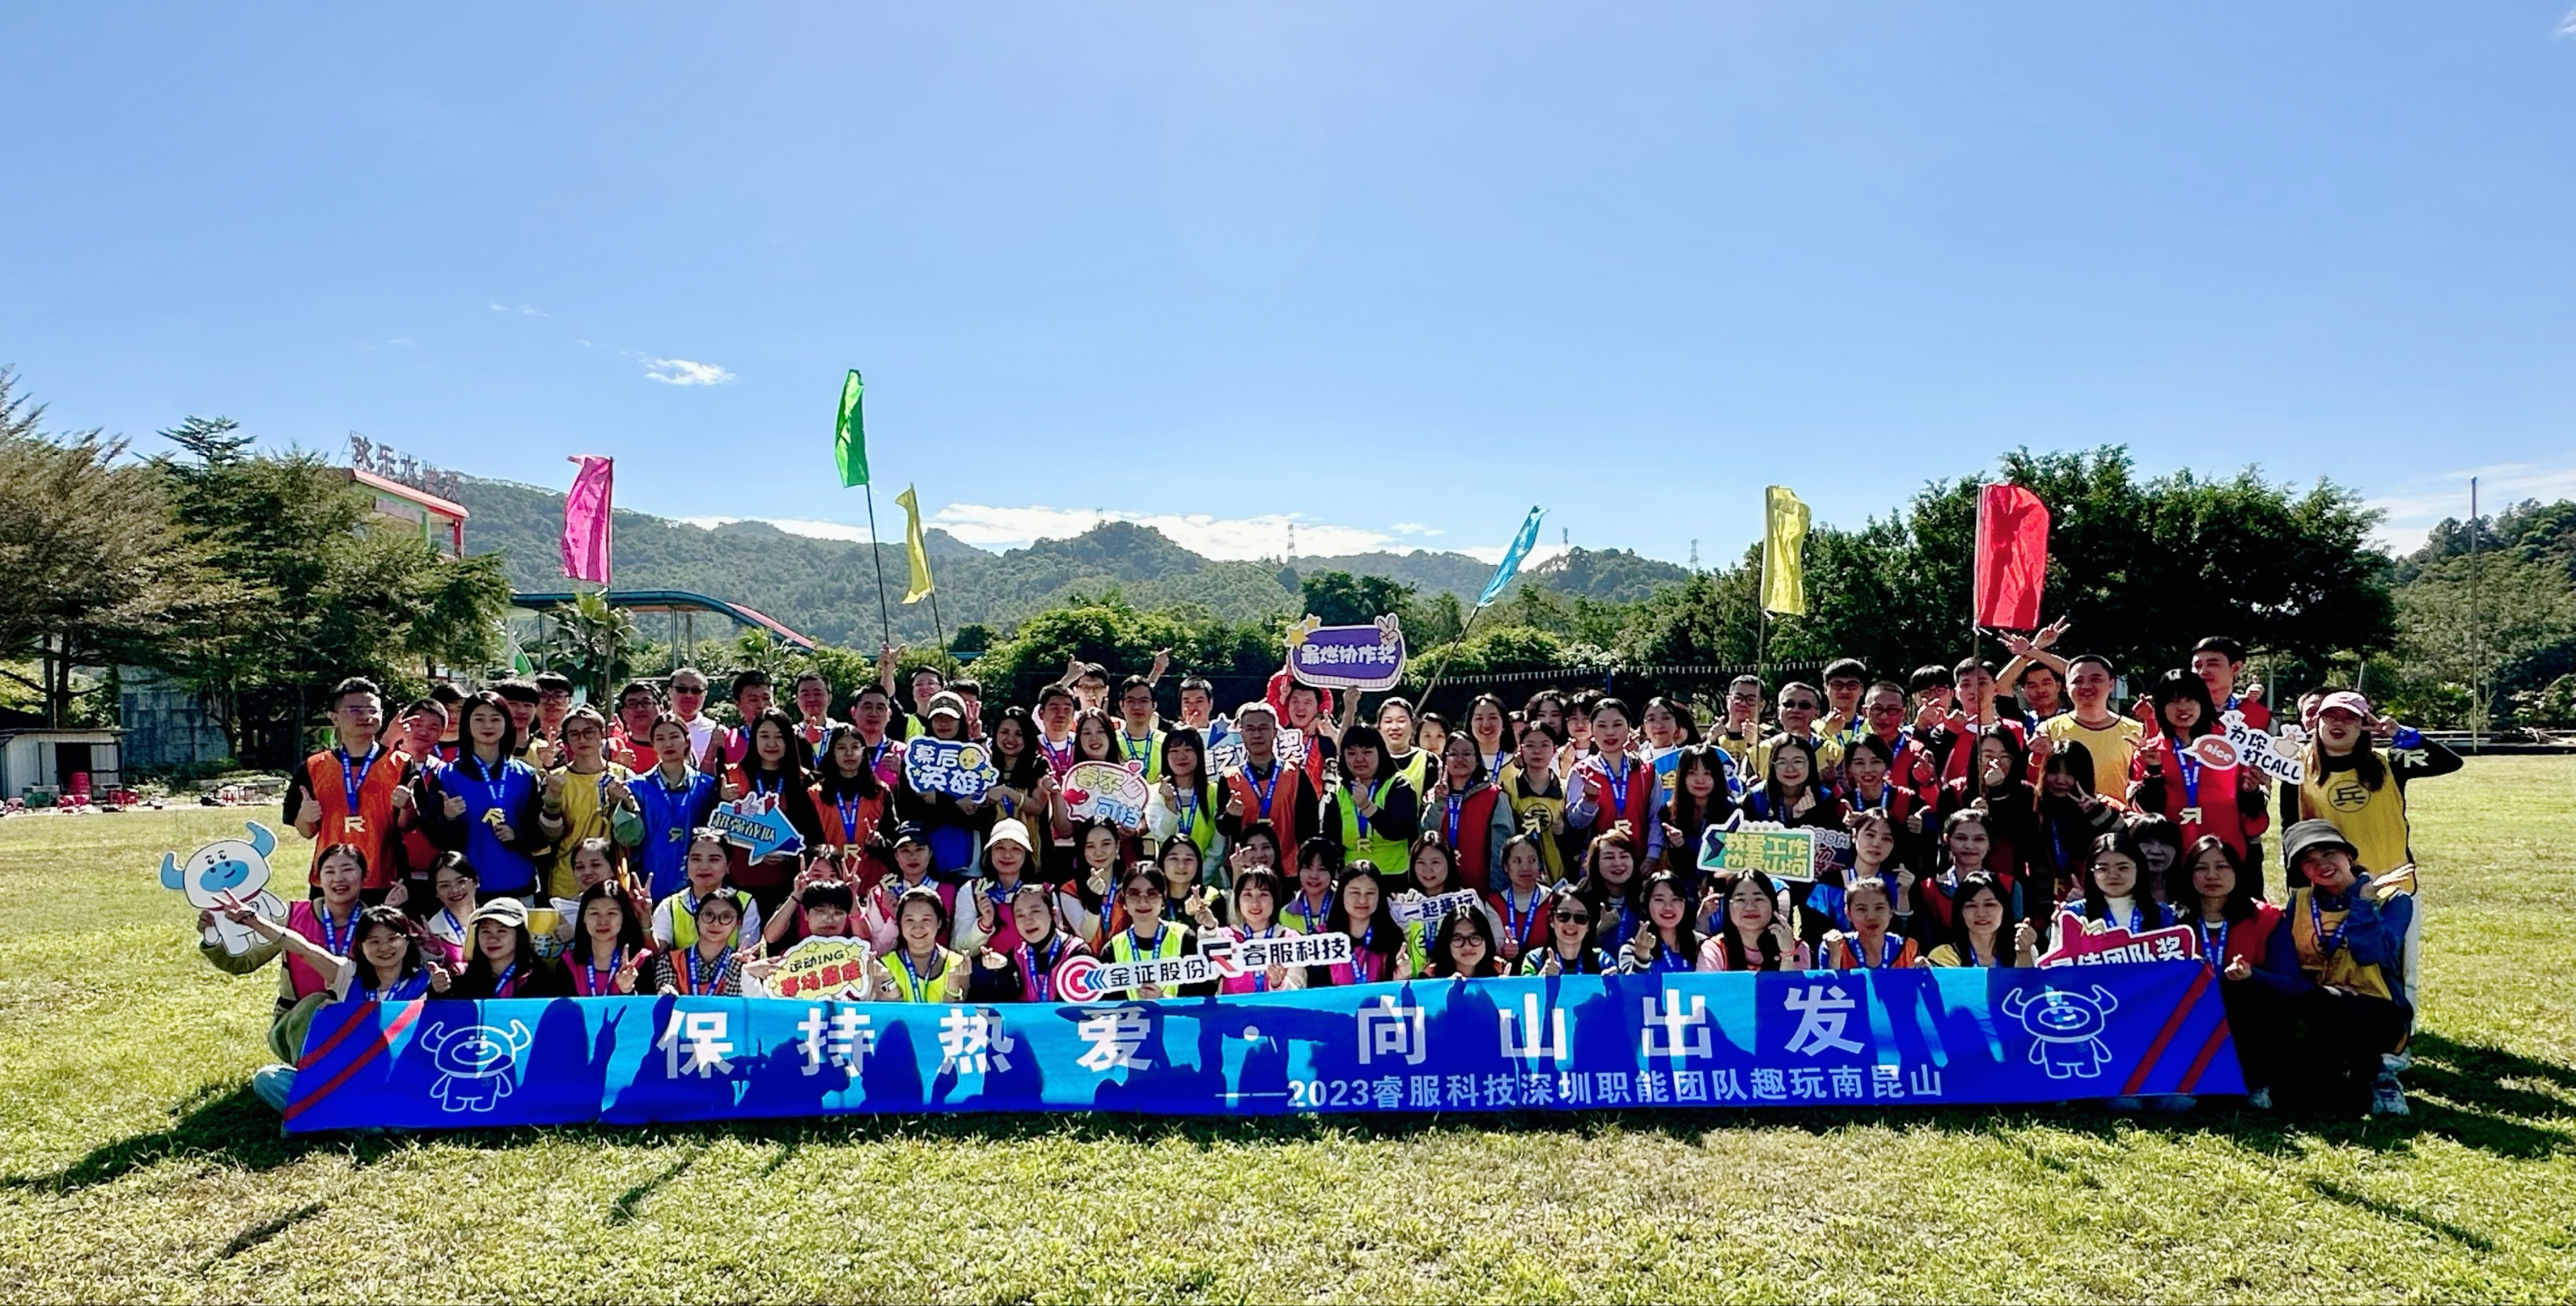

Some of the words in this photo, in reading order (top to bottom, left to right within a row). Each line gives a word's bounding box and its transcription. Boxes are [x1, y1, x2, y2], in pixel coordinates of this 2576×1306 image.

[1301, 644, 1396, 665] 最燃协作奖
[2229, 725, 2268, 750] 为你
[913, 743, 959, 768] 幕后
[2204, 743, 2233, 762] nice
[919, 764, 982, 795] 英雄
[1076, 765, 1125, 794] 春不
[2333, 784, 2366, 806] 兵
[1724, 833, 1810, 857] 我爱工作
[1724, 853, 1808, 877] 也爱山河
[1242, 937, 1346, 967] 睿服科技
[1110, 960, 1205, 985] 金证股份
